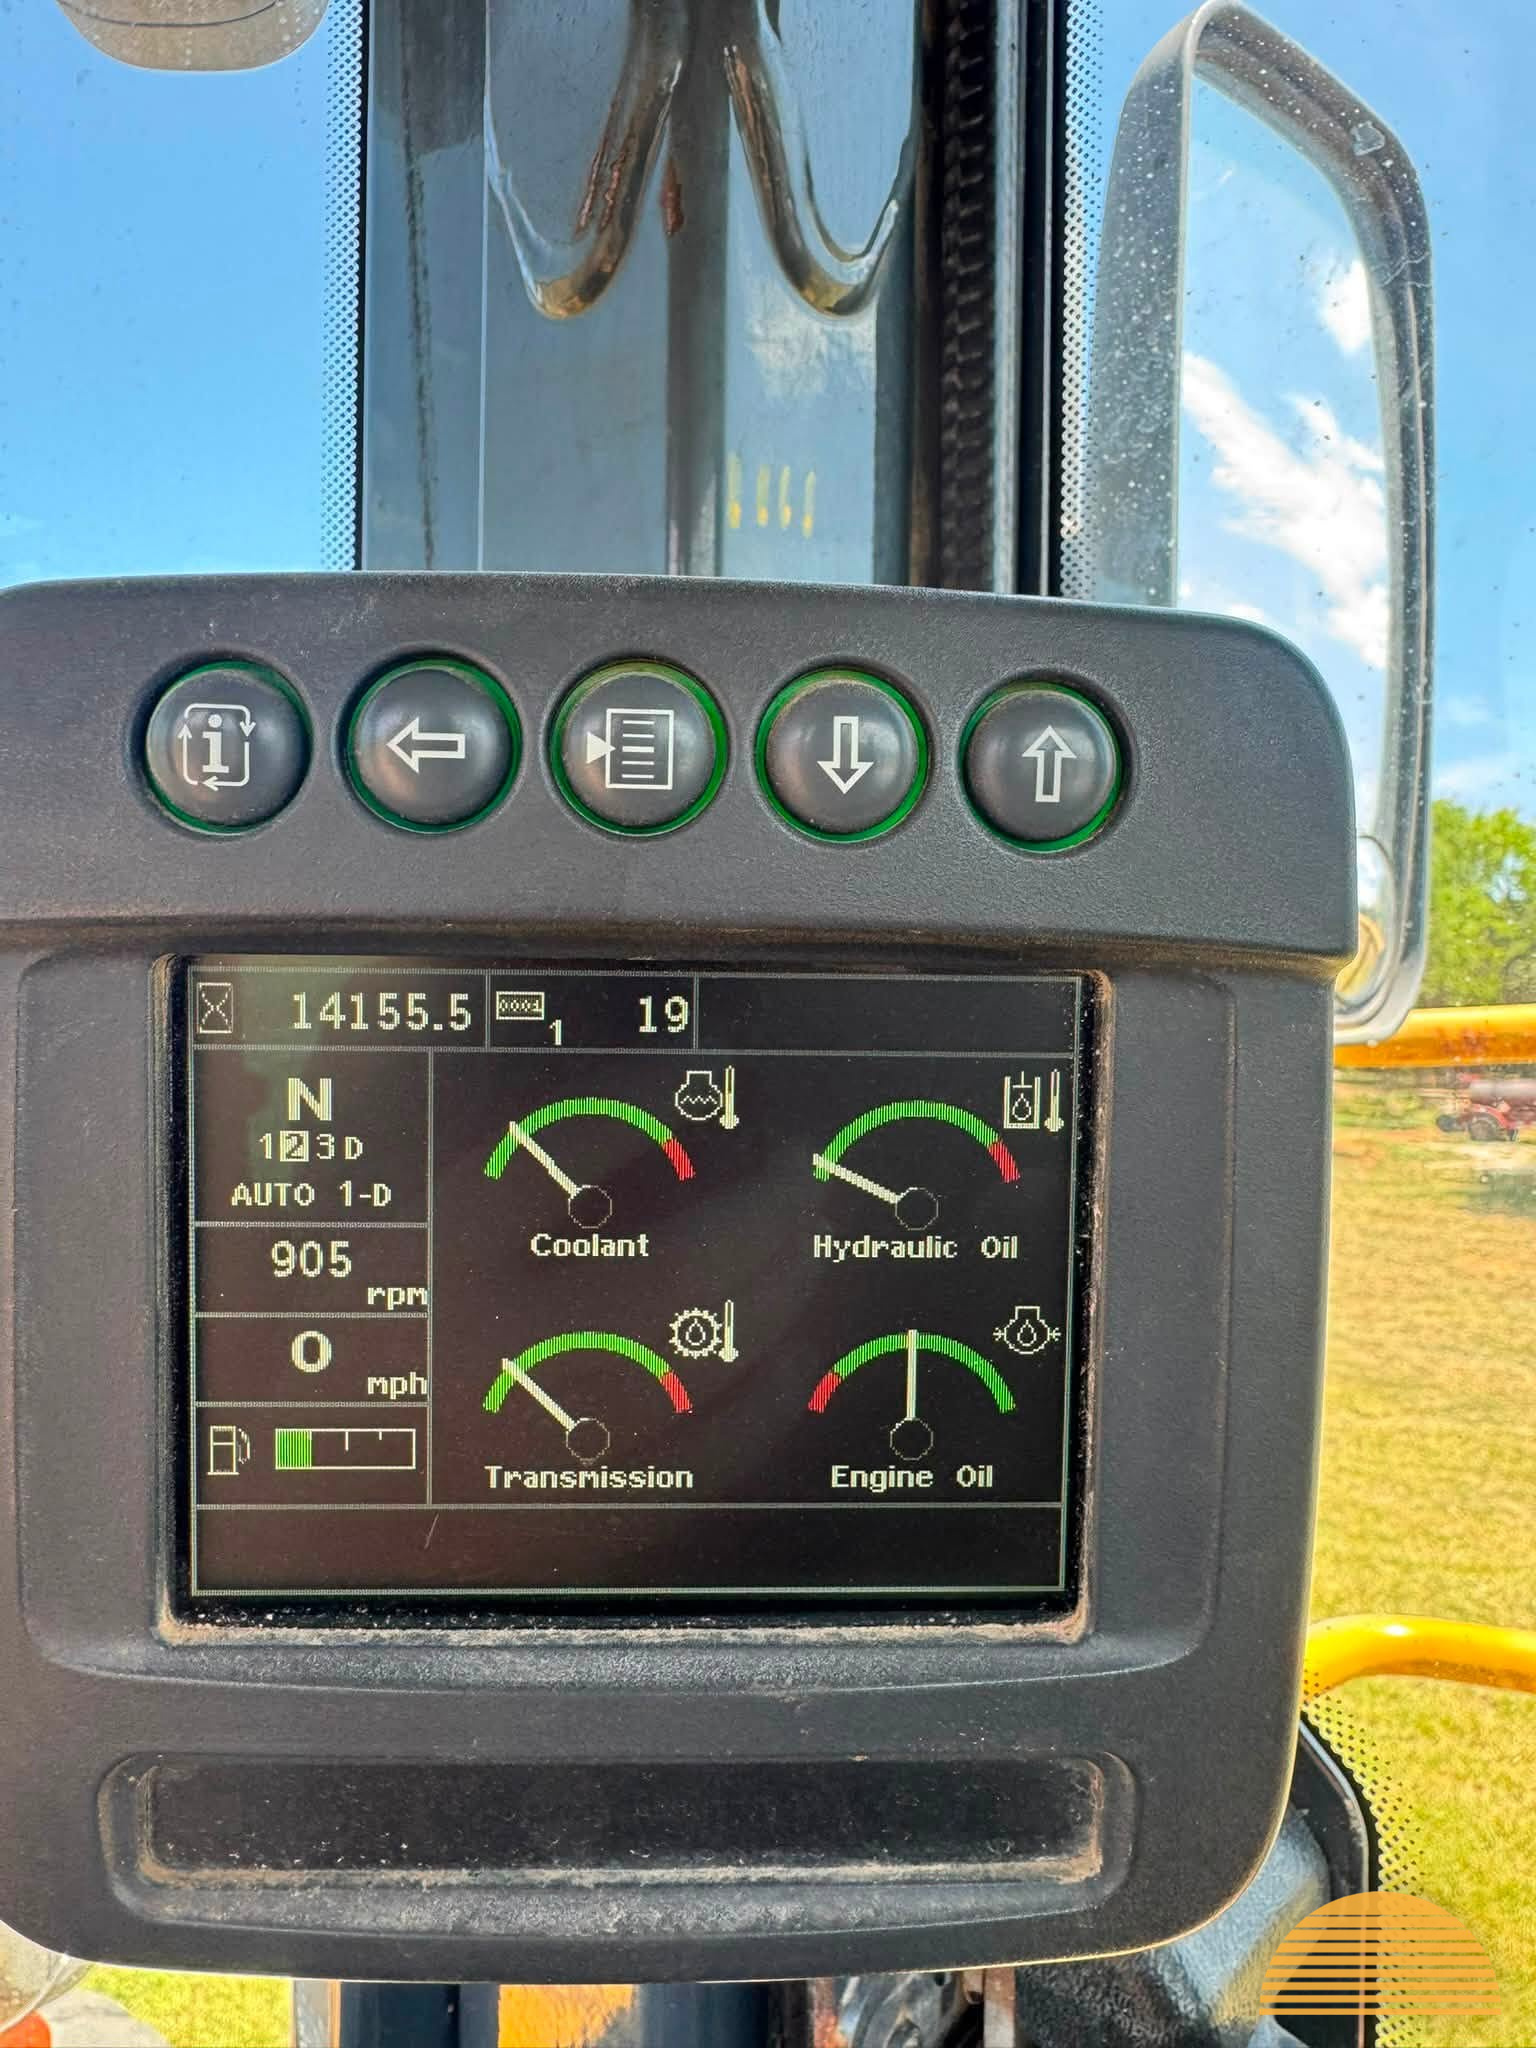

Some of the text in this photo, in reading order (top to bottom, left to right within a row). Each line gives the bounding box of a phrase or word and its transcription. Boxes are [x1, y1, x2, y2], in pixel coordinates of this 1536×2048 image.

[289, 991, 472, 1032] 14155.5
[638, 995, 689, 1034] 19
[549, 1018, 563, 1047] 1
[287, 1076, 332, 1122] N
[231, 1180, 392, 1207] AUTO 1-D
[271, 1239, 353, 1278] 905
[530, 1232, 650, 1258] Coolant
[813, 1234, 1018, 1263] Hydraulic Oil
[367, 1286, 428, 1311] rpm
[291, 1330, 333, 1373] 0
[367, 1371, 428, 1400] mph
[484, 1465, 694, 1489] Transmission
[831, 1464, 993, 1493] Engine Oil
